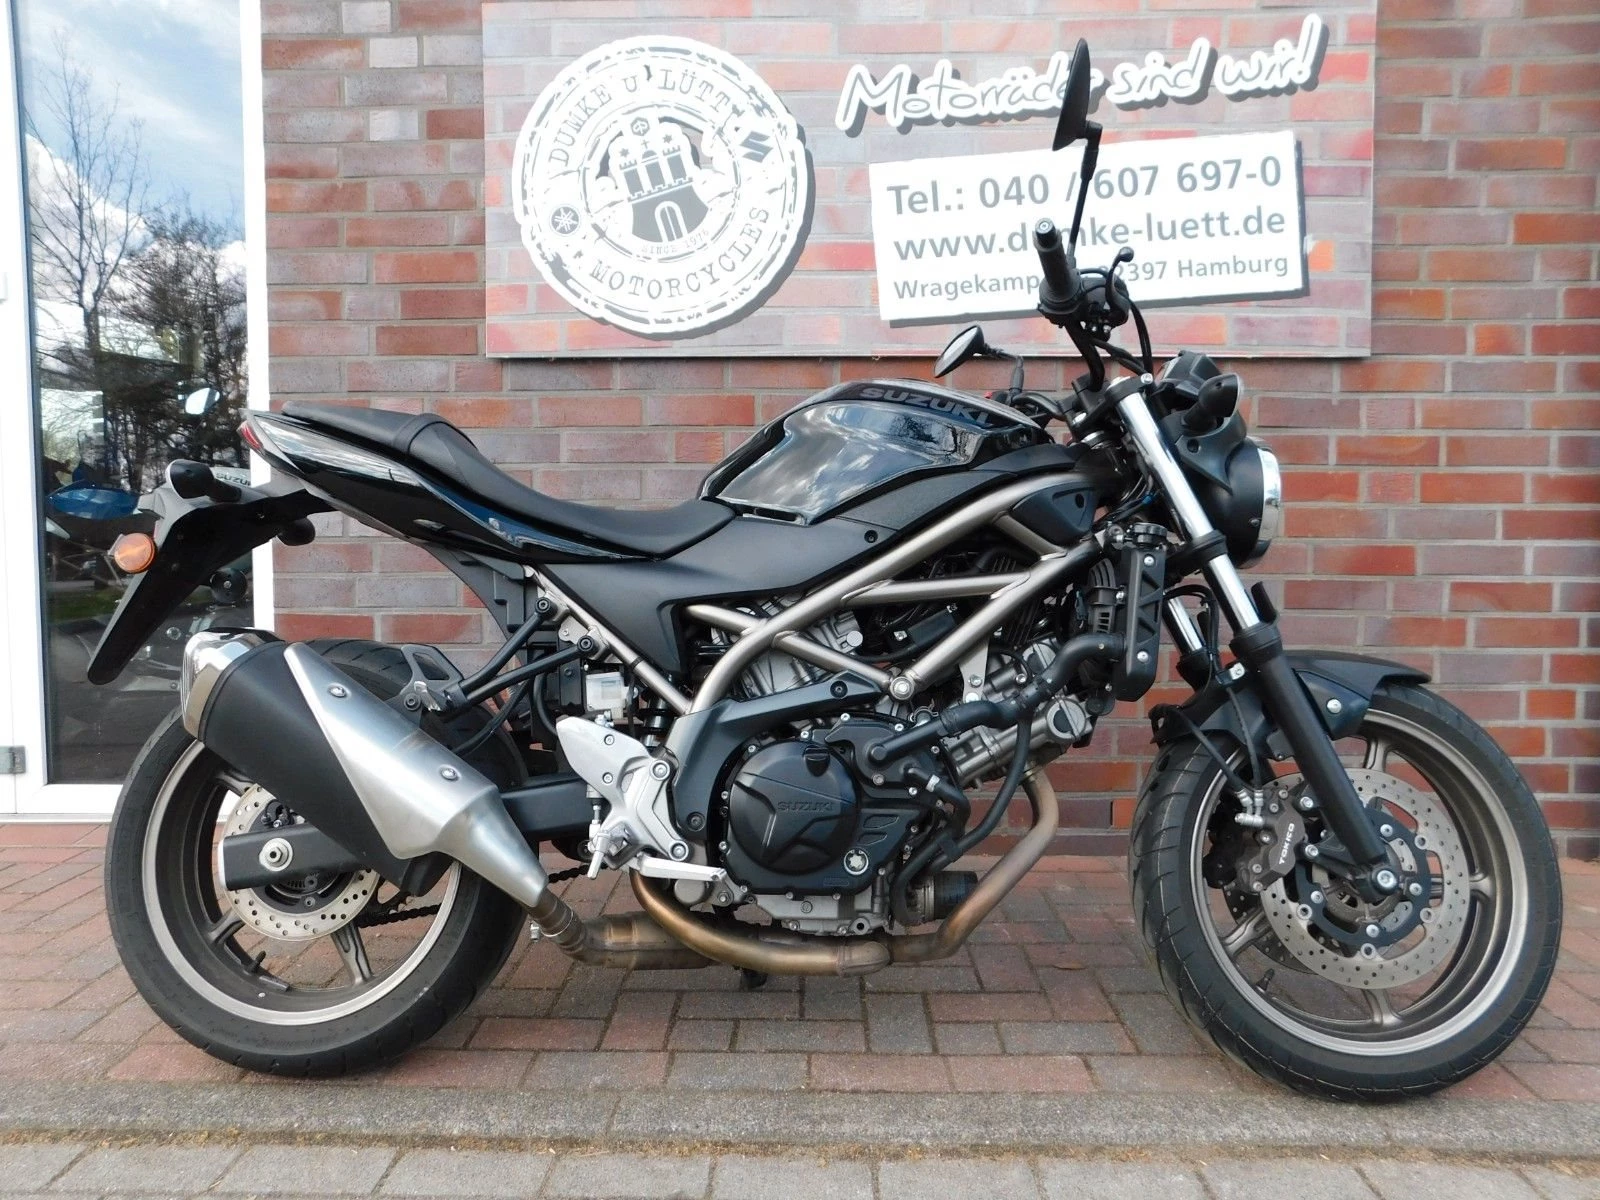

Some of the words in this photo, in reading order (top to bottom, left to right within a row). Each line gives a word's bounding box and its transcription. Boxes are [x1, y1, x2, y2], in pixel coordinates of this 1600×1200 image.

[839, 55, 1101, 126] Motorräde
[1110, 41, 1207, 99] sind
[1218, 17, 1318, 90] wir!
[548, 84, 613, 167] DUMKE
[658, 69, 731, 113] LÜTT
[886, 179, 964, 215] Tel.:
[979, 173, 1050, 208] 040
[1065, 171, 1077, 202] /
[1093, 164, 1159, 200] 607
[1176, 155, 1282, 193] 697-0
[589, 206, 769, 300] MOTORCYCLES
[894, 205, 1285, 261] www.dmke-luett.de
[894, 273, 1040, 301] Wragekamp
[1178, 254, 1288, 278] Hamburg
[860, 386, 990, 425] SUZUKI
[777, 801, 833, 812] SUZUKI
